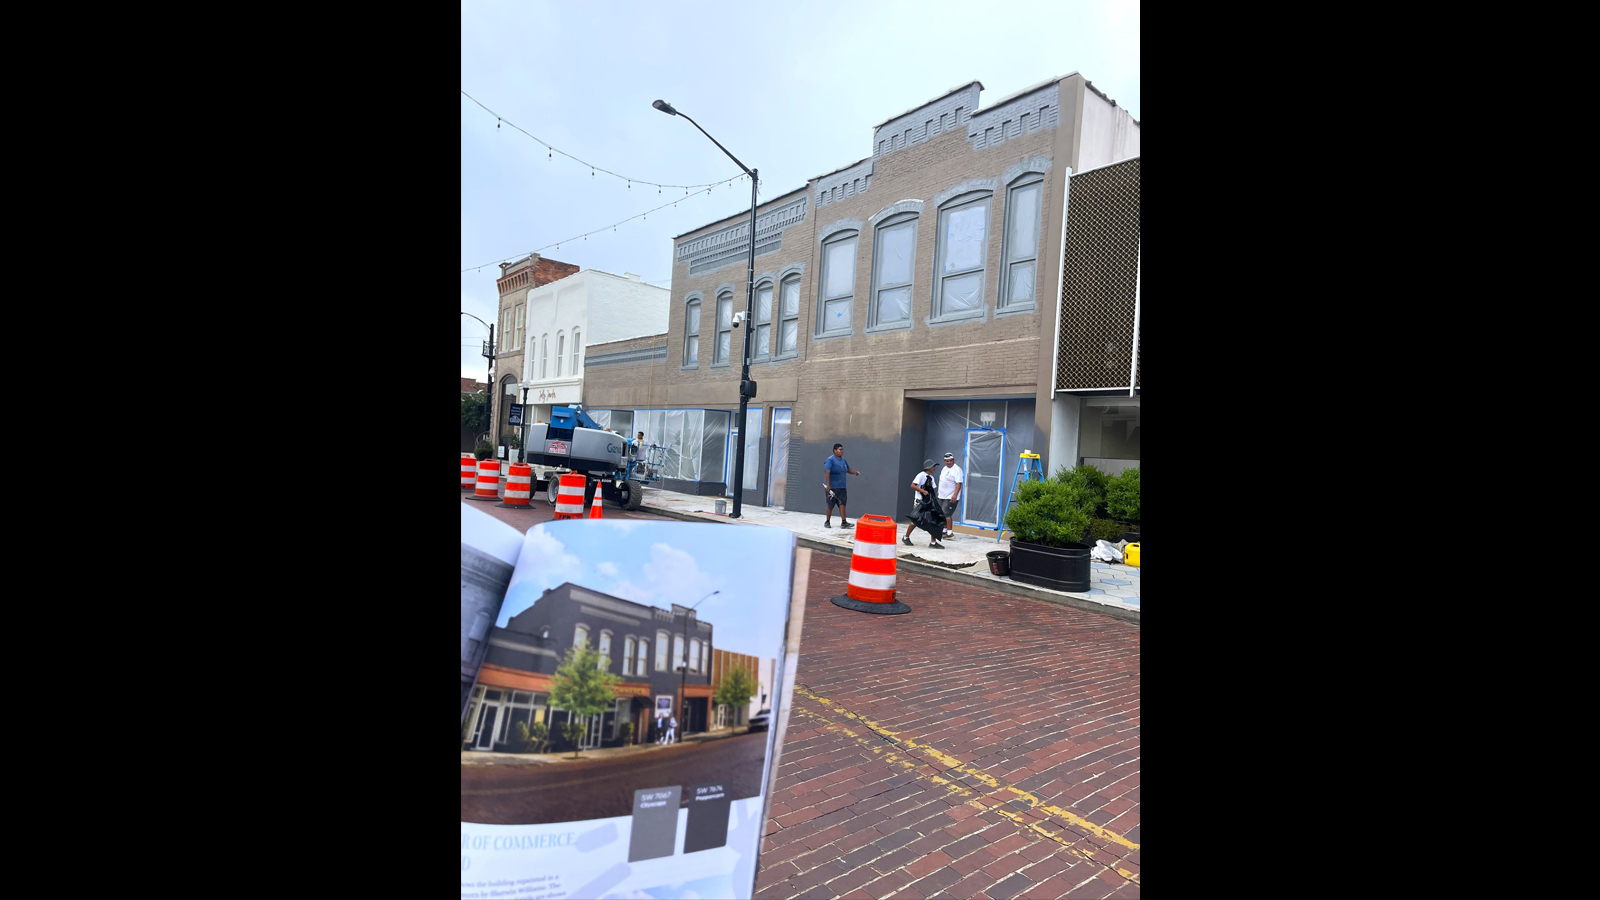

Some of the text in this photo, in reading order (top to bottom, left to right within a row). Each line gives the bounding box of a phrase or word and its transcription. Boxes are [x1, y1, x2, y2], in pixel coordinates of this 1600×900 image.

[641, 791, 672, 802] SW 7067
[697, 787, 708, 795] SW
[472, 834, 492, 851] OF
[493, 832, 575, 850] COMMERCE
